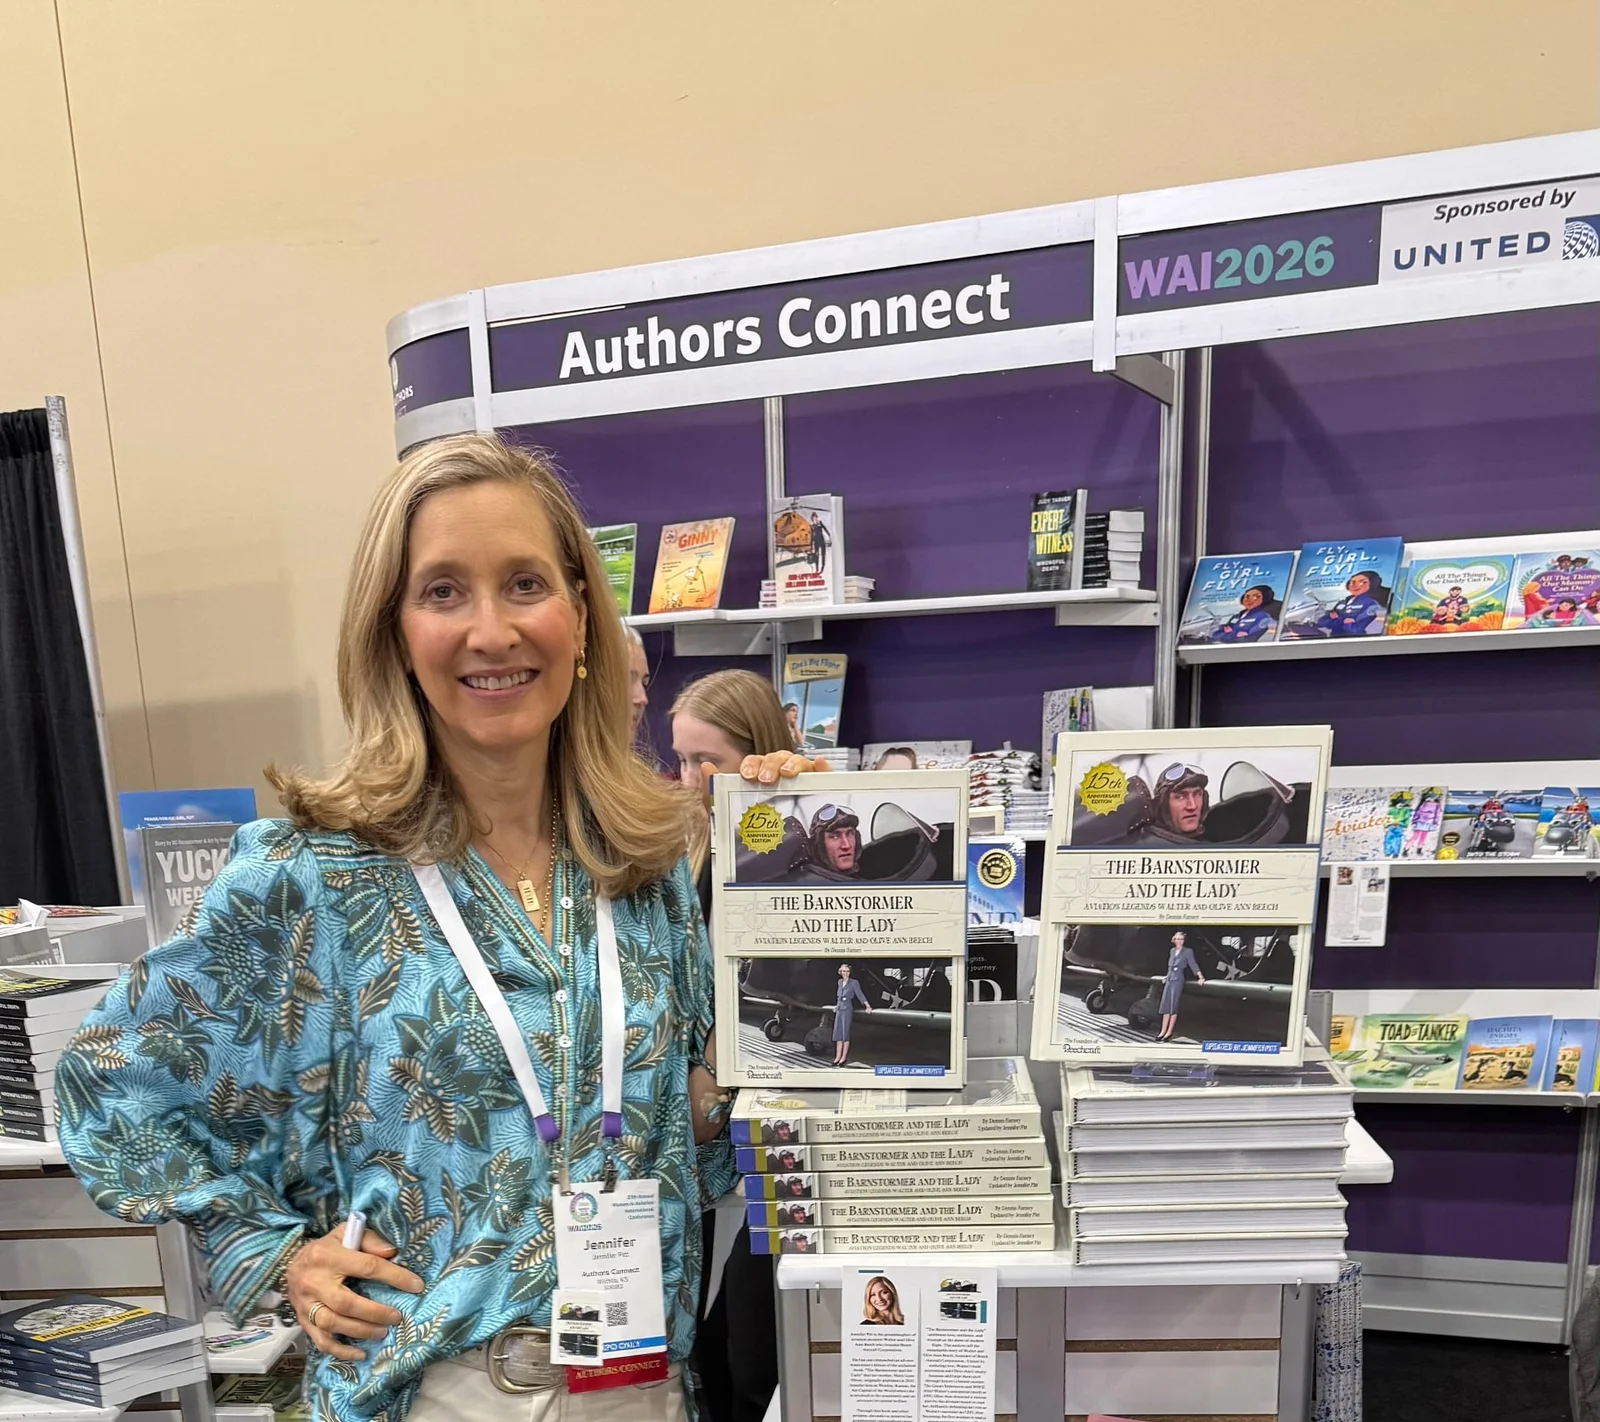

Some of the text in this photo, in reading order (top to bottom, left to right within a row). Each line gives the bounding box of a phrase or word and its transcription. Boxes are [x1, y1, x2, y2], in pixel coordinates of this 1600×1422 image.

[1433, 188, 1577, 224] Sponsored by
[1393, 231, 1551, 270] UNITED
[1124, 236, 1334, 300] WAI2026
[559, 273, 1011, 379] Authors Connect
[1031, 509, 1065, 533] EXPERT
[678, 528, 719, 549] GINNY
[1036, 532, 1073, 555] WITNESS
[1442, 577, 1465, 585] Daddy
[1561, 579, 1594, 587] Mommy
[1086, 772, 1122, 790] 15th
[745, 813, 779, 829] 15th
[1325, 816, 1390, 838] Aviator
[1106, 857, 1260, 874] THE BARNSTORMER
[1125, 881, 1240, 898] AND THE LADY
[771, 893, 913, 910] THE BARNSTORMER
[1121, 903, 1156, 911] LEGENDS
[1209, 903, 1232, 911] OLIVE
[1252, 903, 1279, 911] BEECH
[791, 916, 897, 932] AND THE LADY
[909, 936, 933, 944] BEECH
[970, 963, 998, 973] journey.
[1380, 1023, 1411, 1040] TOAD
[1418, 1023, 1459, 1041] TANKER
[816, 1118, 971, 1132] THE BARNSTORMER AND THE LADY
[820, 1148, 974, 1161] THE BARNSTORMER AND THE LADY
[828, 1179, 844, 1188] THE
[847, 1177, 916, 1187] BARNSTORMER
[918, 1178, 935, 1186] AND
[955, 1175, 982, 1185] LADY
[831, 1208, 847, 1216] THE
[849, 1205, 918, 1216] BARNSTORMER
[920, 1207, 937, 1215] AND
[958, 1204, 983, 1214] LADY
[584, 1237, 636, 1250] Jennifer
[833, 1236, 848, 1244] THE
[851, 1234, 920, 1244] BARNSTORMER
[959, 1232, 985, 1242] LADY
[42, 1311, 144, 1339] Riding the Lines
[576, 1360, 661, 1379] AUTHORS CONNECT
